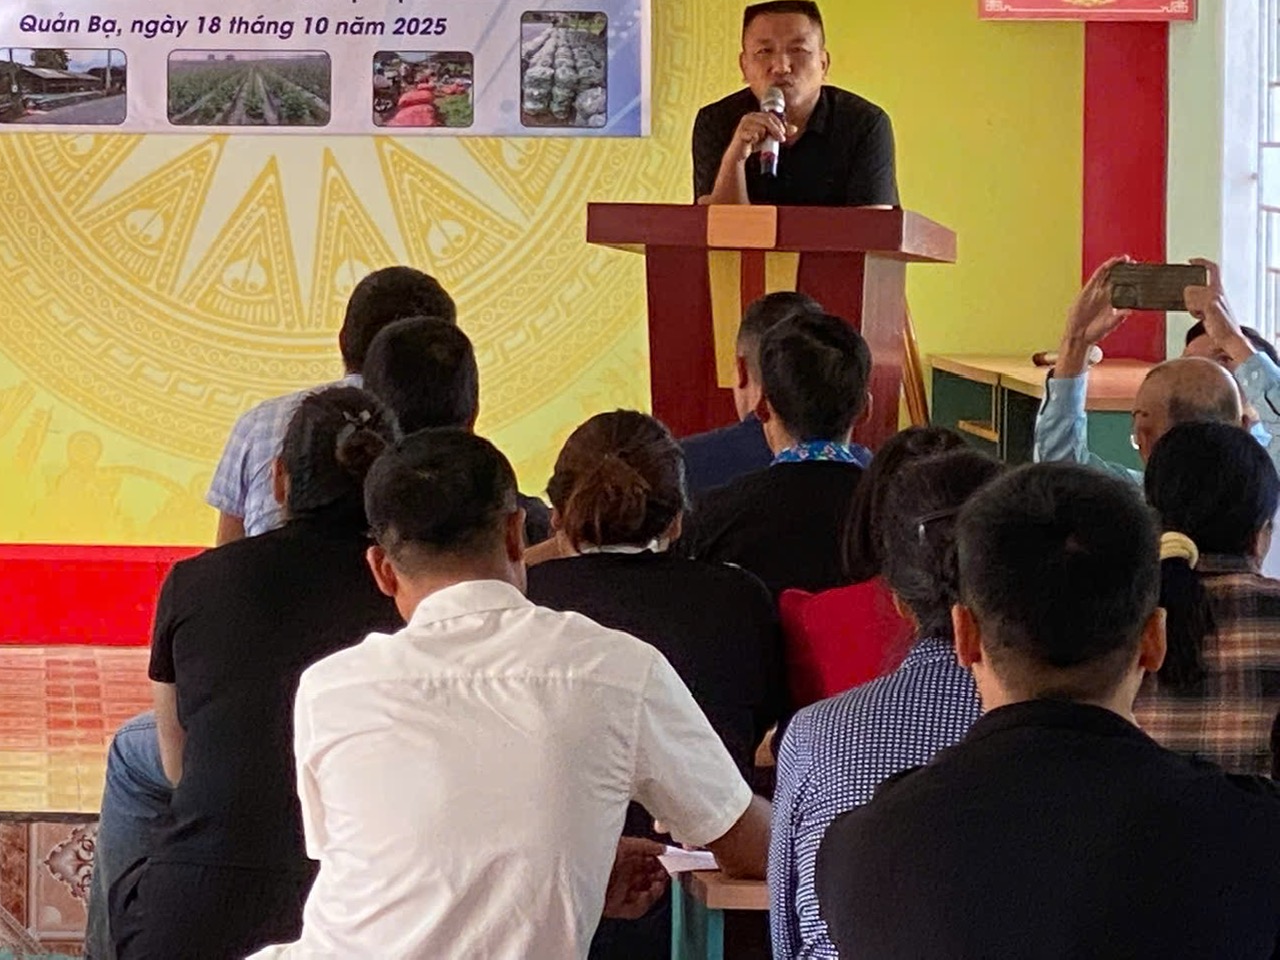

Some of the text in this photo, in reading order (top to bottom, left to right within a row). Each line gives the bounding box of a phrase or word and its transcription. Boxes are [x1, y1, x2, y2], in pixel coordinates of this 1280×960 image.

[19, 12, 447, 39] Quản Bạ, ngày 18 tháng 10 năm 2025
